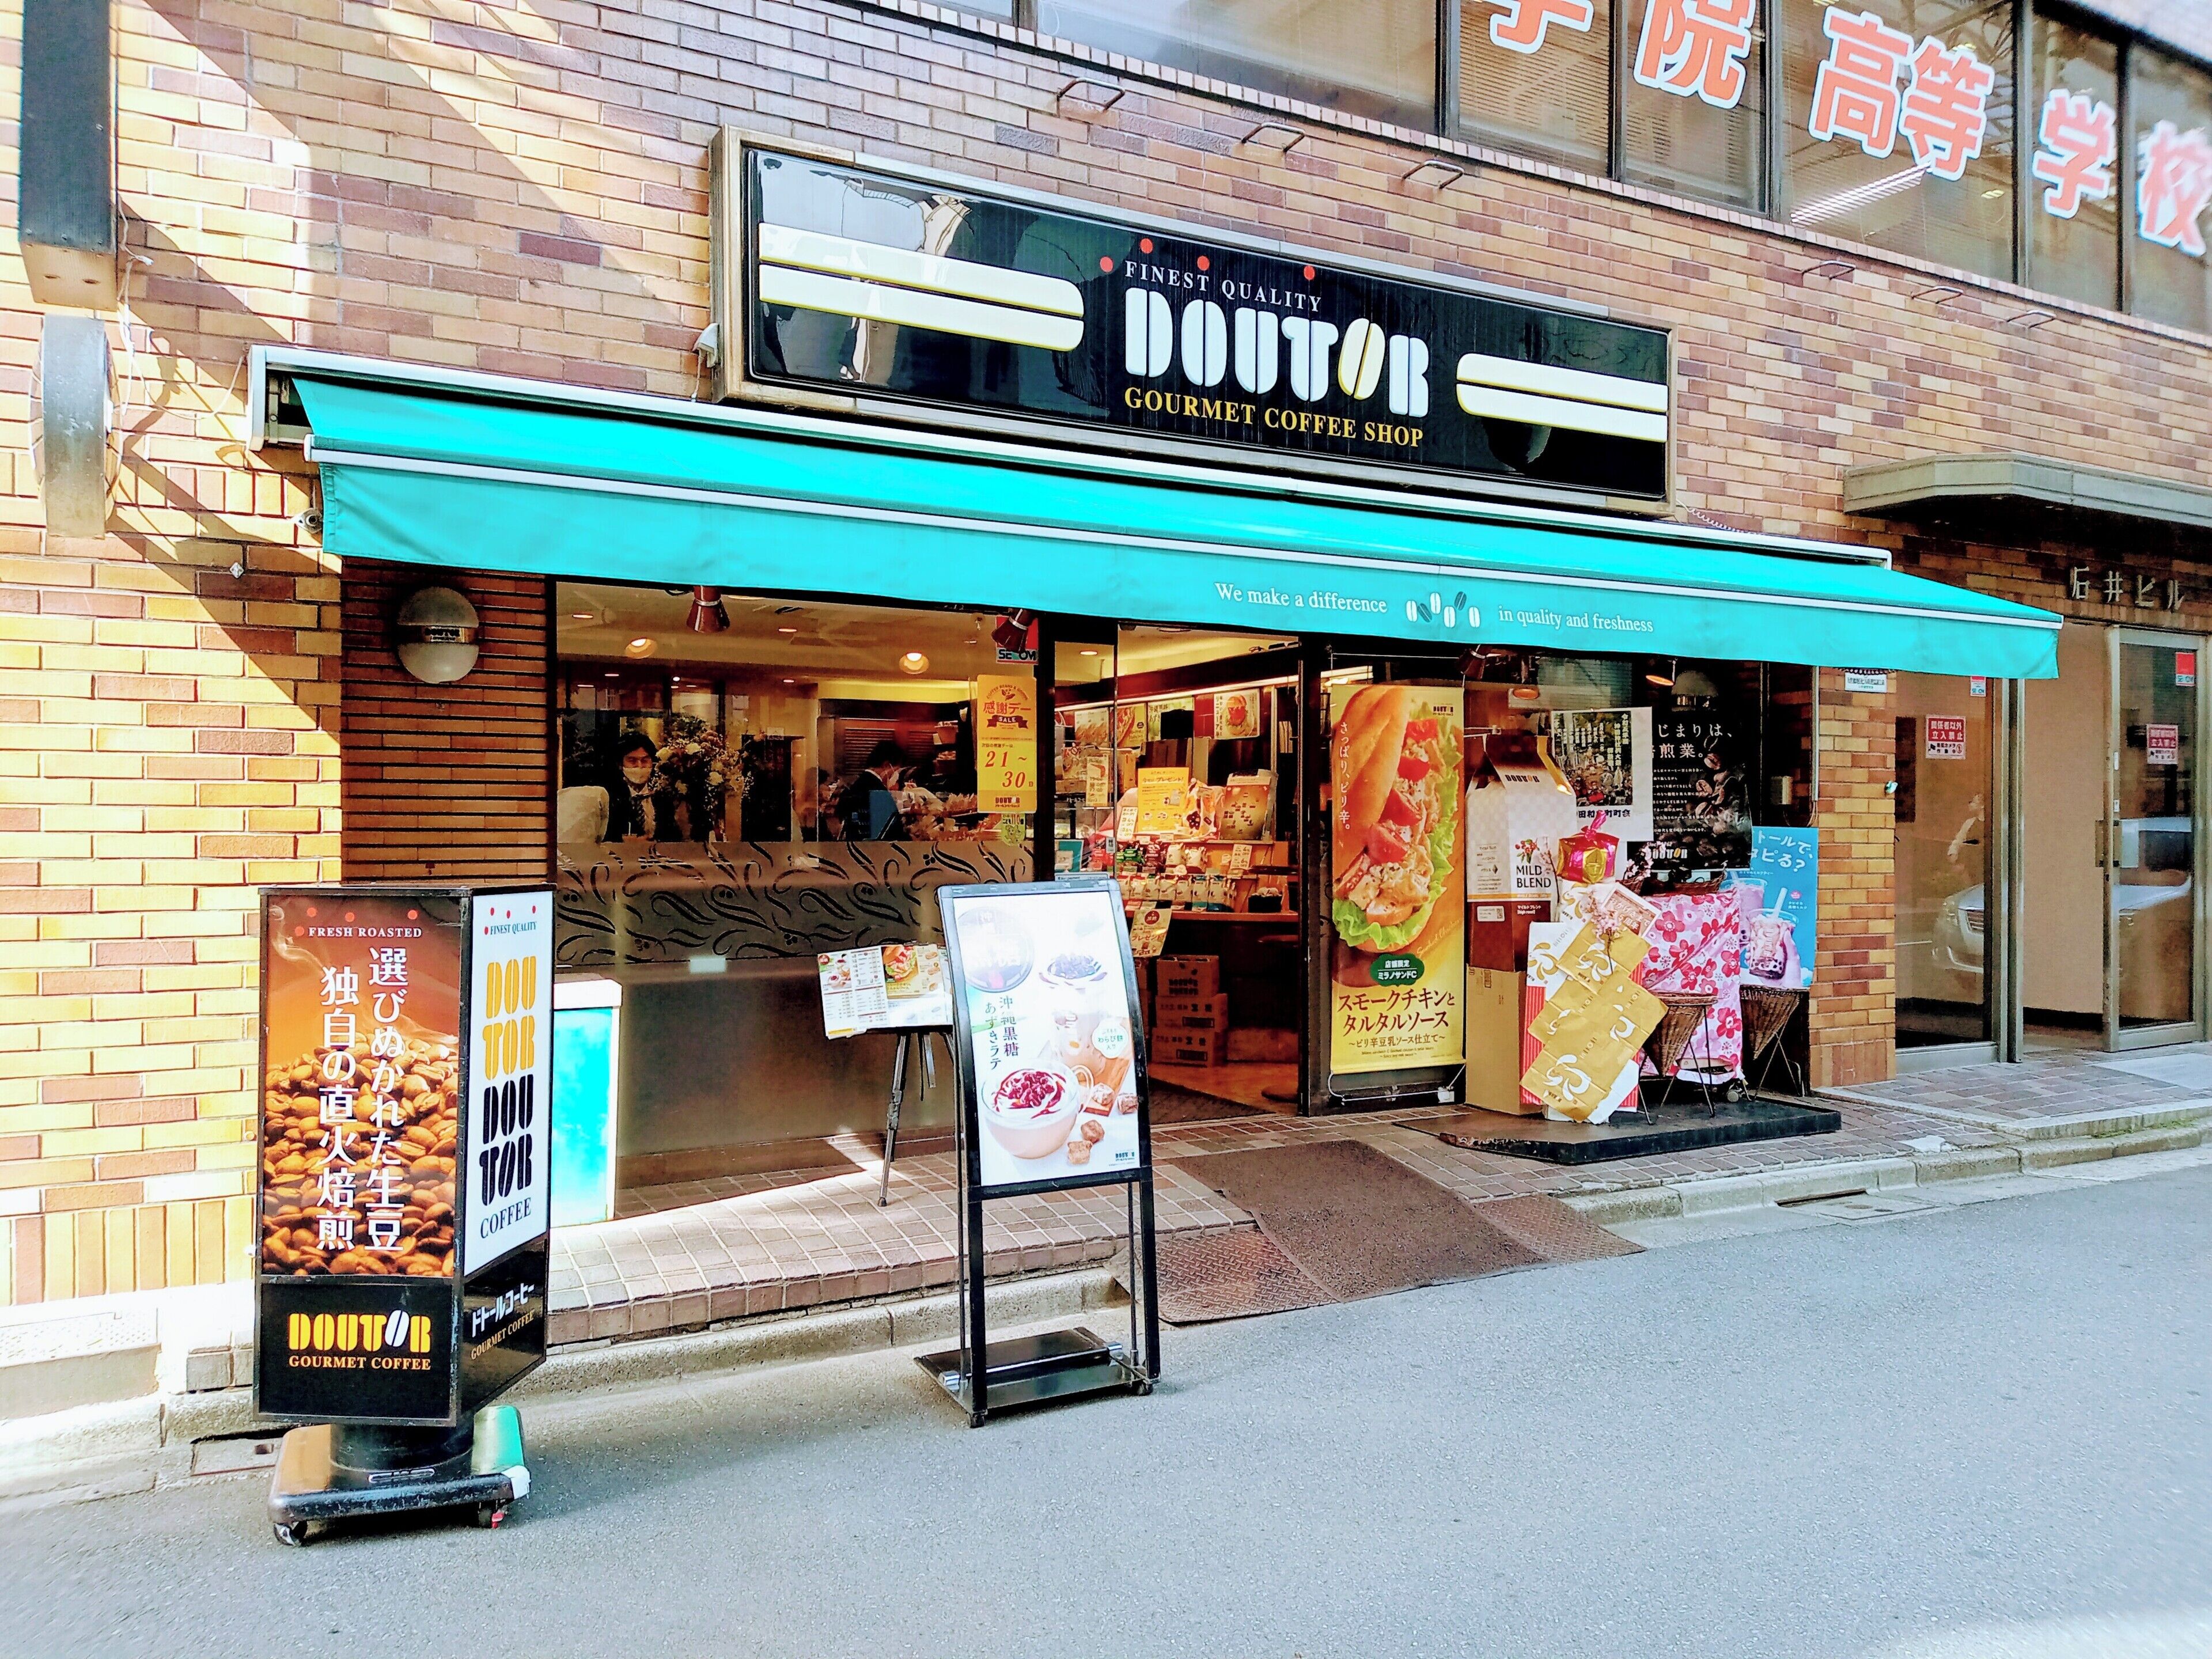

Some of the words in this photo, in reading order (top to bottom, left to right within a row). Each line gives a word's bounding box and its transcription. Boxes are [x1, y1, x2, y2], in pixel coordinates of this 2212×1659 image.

[1125, 260, 1209, 291] FINEST
[1221, 278, 1323, 312] QUALITY
[1125, 287, 1429, 418] DOUTOR
[1124, 387, 1256, 425] GOURMET
[1264, 408, 1357, 439] COFFEE
[1363, 422, 1424, 448] SHOP
[1214, 582, 1243, 601] We
[1247, 588, 1290, 607] make
[1295, 594, 1305, 607] a
[1308, 591, 1388, 613] difference
[1499, 605, 1513, 622] in
[1517, 609, 1562, 630] quality
[1566, 613, 1589, 628] and
[1592, 613, 1654, 632] freshness
[983, 700, 1032, 715] 感謝デー
[1931, 720, 1963, 730] 関係者以外
[1931, 730, 1963, 740] 立入禁止
[1338, 722, 1351, 830] さっぱり、ピリ辛。
[1505, 774, 1540, 783] DOUTOR
[1577, 809, 1631, 819] 田和町町会
[1645, 847, 1688, 859] OUTOR
[1752, 830, 1813, 859] トールで、
[1516, 864, 1543, 876] MILD
[1516, 877, 1551, 888] BLEND
[308, 926, 353, 937] FRESH
[358, 927, 422, 938] ROASTED
[490, 923, 512, 935] FINEST
[512, 921, 537, 933] QUALITY
[1378, 970, 1418, 980] ミラノサンドC
[1384, 959, 1411, 968] 店舗限定
[486, 956, 536, 1019] DOU
[1337, 987, 1456, 1013] スモークチキンと
[984, 1002, 1002, 1070] あずきラテ
[999, 995, 1020, 1057] 沖縄黒糖
[1343, 1010, 1449, 1037] タルタルソース
[482, 1015, 535, 1081] TOR
[316, 965, 360, 1251] 独自の直火焙煎
[365, 946, 409, 1252] 選びぬかれた生豆
[483, 1074, 533, 1145] DOU
[479, 1133, 532, 1206] TOR
[480, 1197, 531, 1239] COFFEE
[289, 1309, 431, 1353] DOUTOR
[471, 1282, 535, 1338] ドトールコーヒー
[471, 1327, 506, 1360] GOURMET
[507, 1309, 535, 1335] COFFEE
[289, 1355, 367, 1369] GOURMET
[370, 1357, 431, 1370] COFFEE
